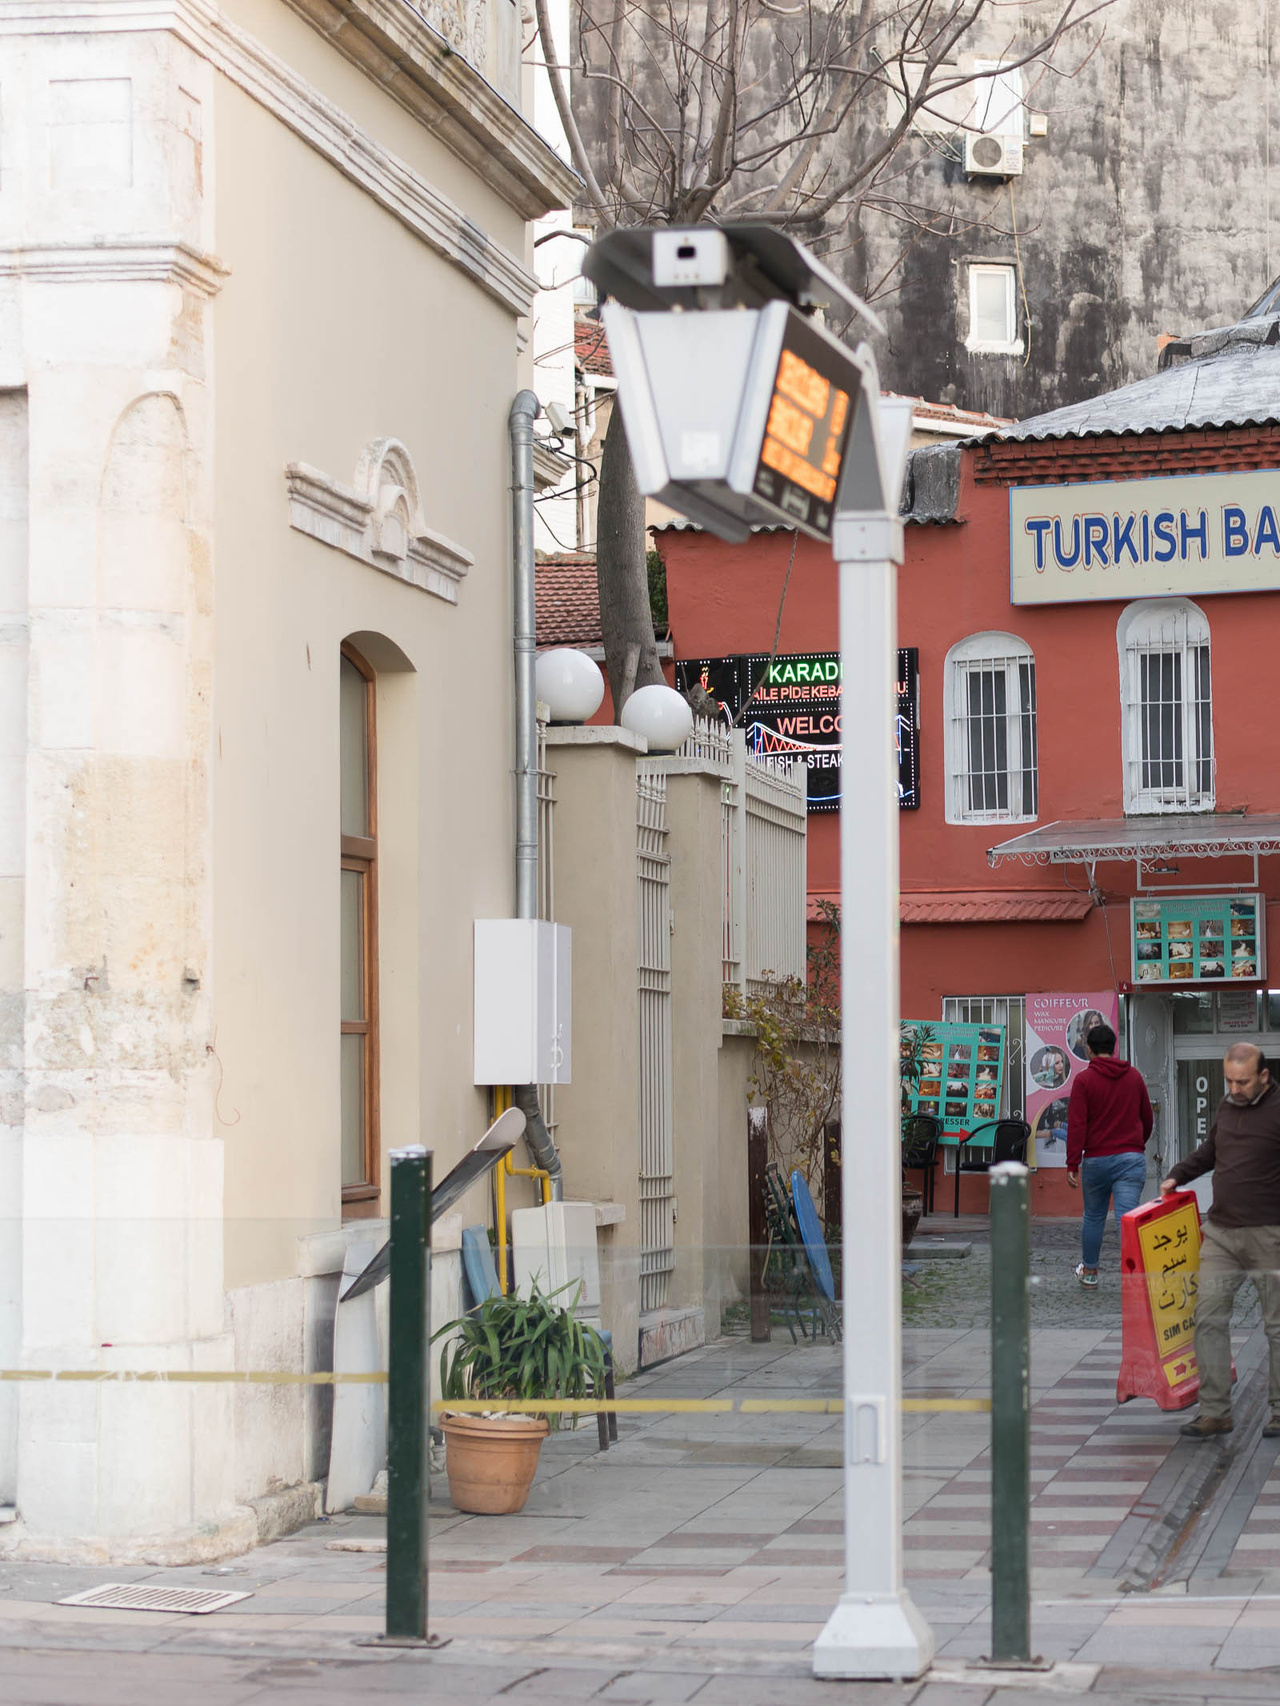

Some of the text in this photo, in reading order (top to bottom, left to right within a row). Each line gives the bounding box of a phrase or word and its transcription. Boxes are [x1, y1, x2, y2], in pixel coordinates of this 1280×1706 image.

[1026, 510, 1207, 569] TURKISH
[768, 662, 843, 684] KARAD
[780, 685, 810, 699] PİDE
[811, 685, 843, 698] KEBA
[776, 715, 843, 735] WELCO
[766, 755, 793, 770] FISH
[1033, 998, 1089, 1008] COIFFEUR
[940, 1117, 970, 1126] RESSER
[1163, 1316, 1197, 1341] SIM CA
